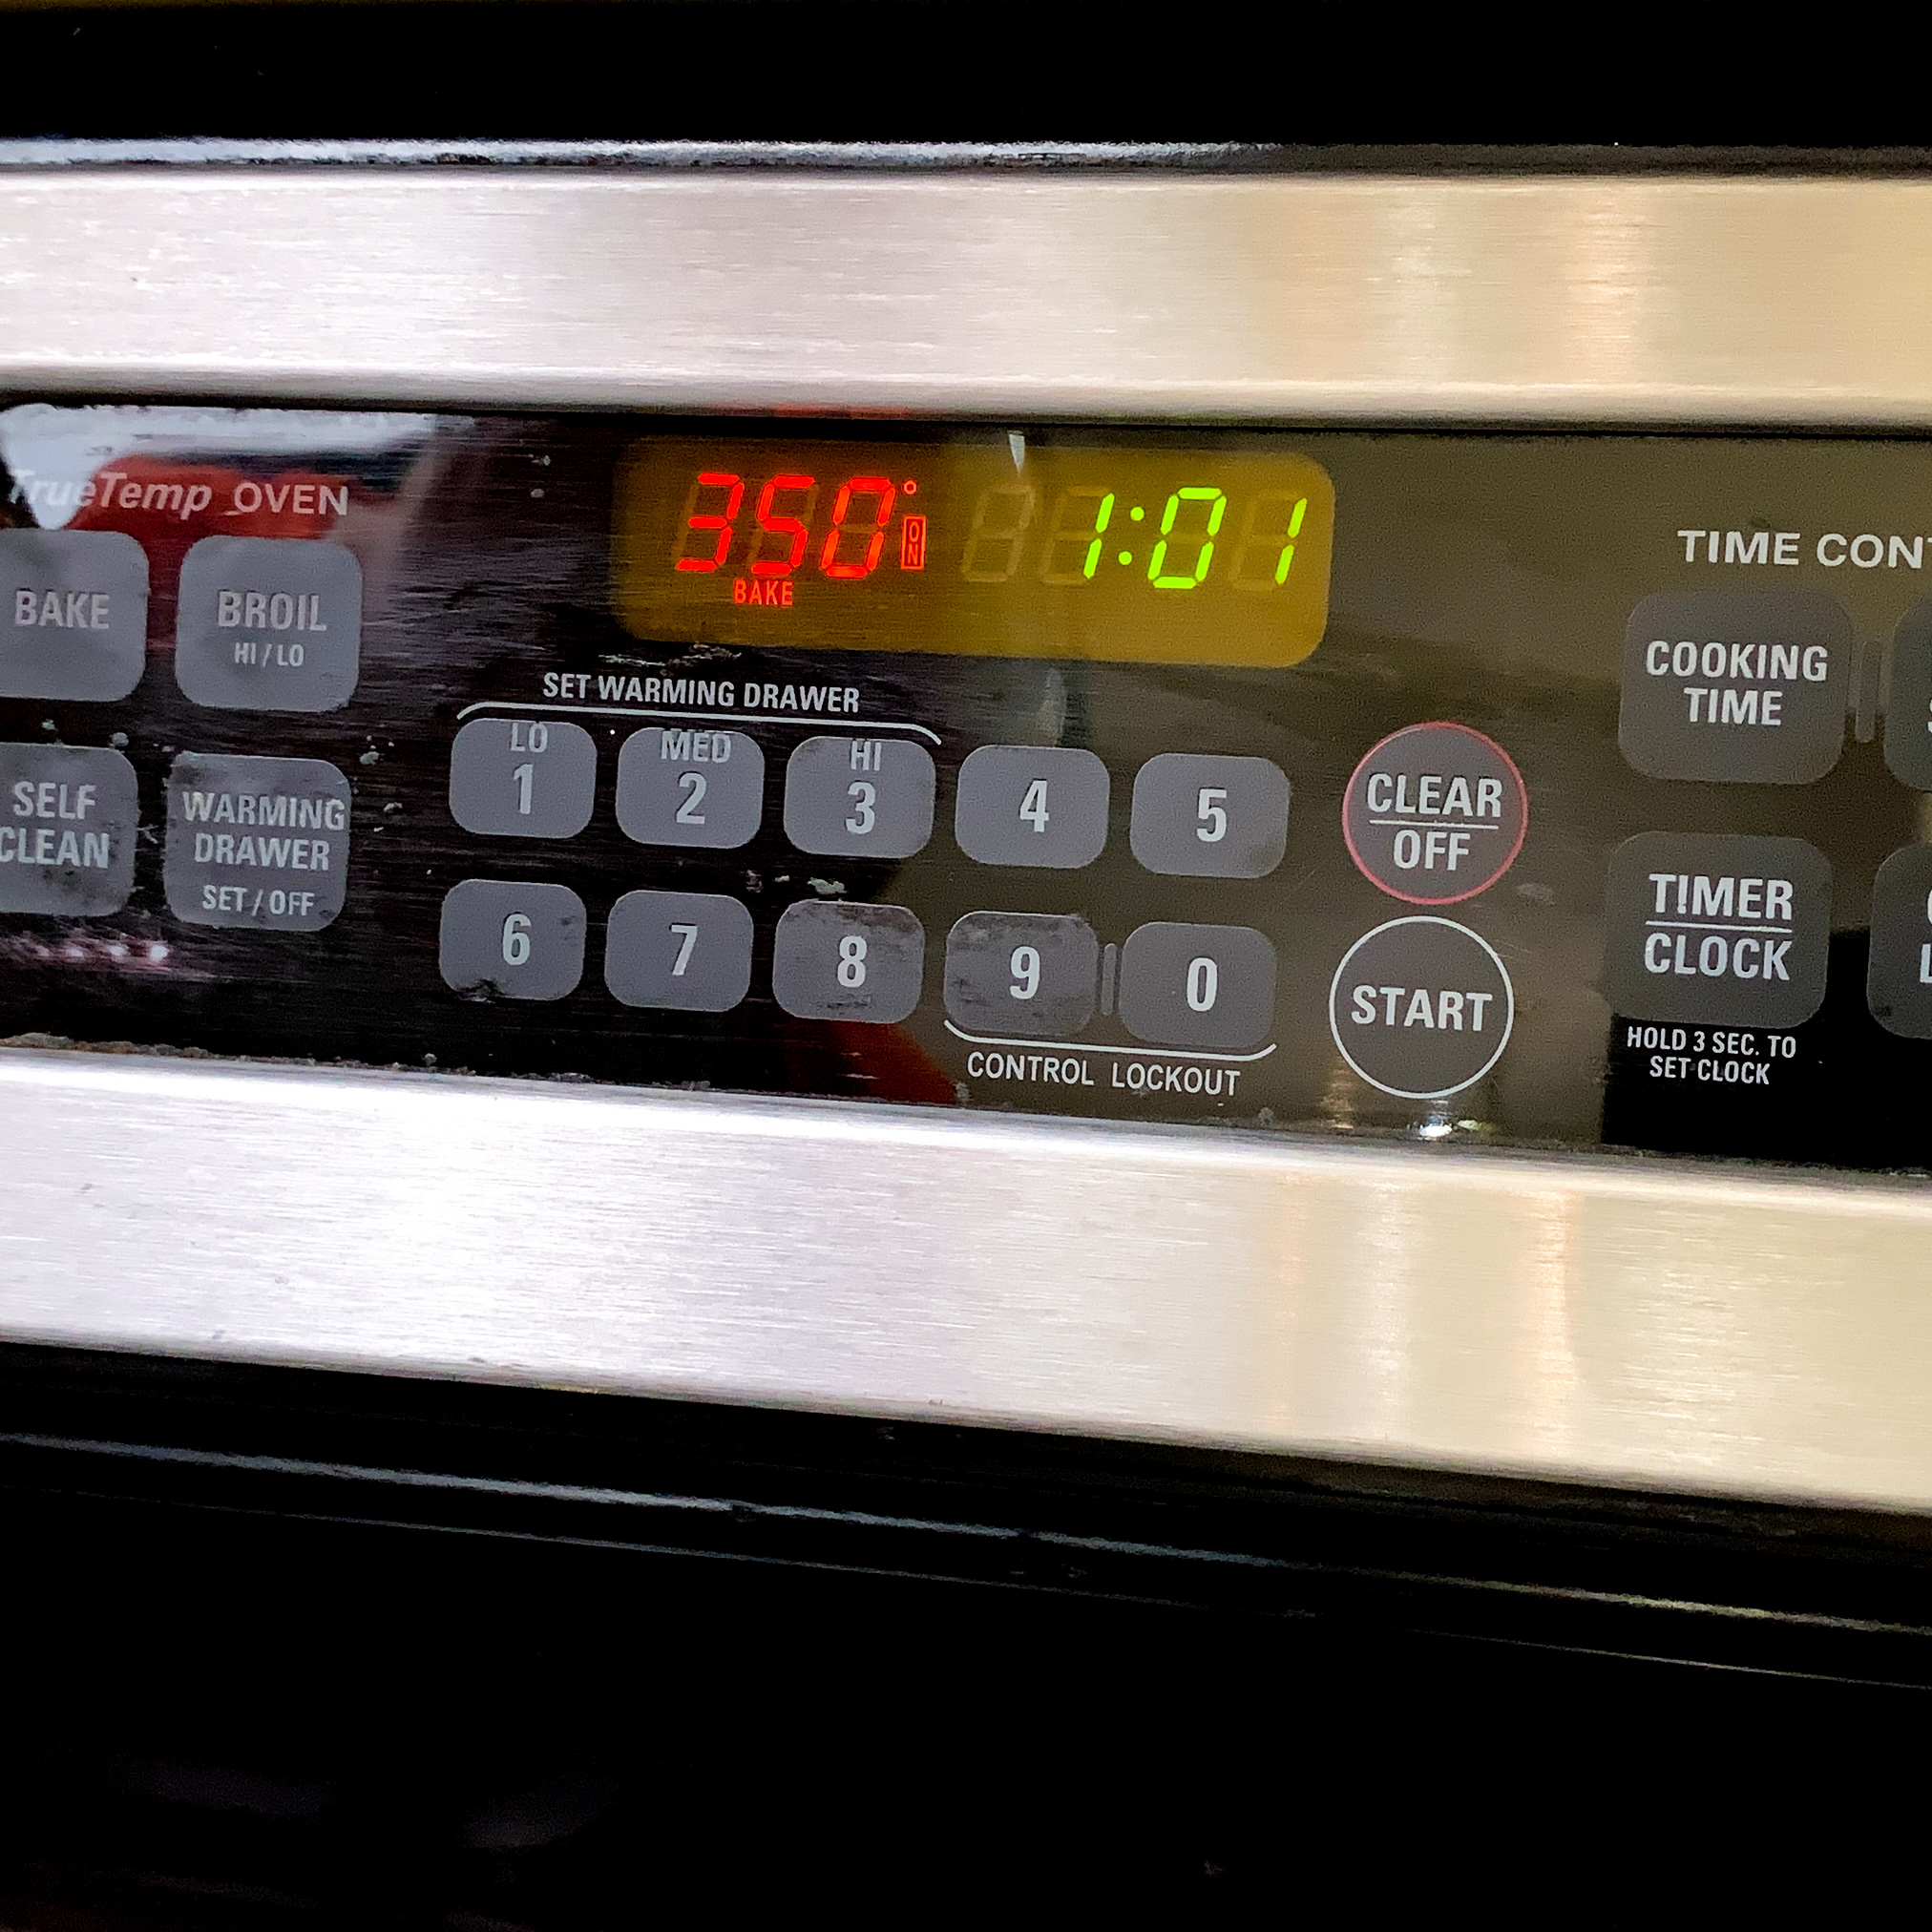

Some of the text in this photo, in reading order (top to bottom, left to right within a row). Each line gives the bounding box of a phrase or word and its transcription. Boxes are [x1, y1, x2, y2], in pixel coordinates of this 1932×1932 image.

[10, 469, 349, 520] TrueTemp OVEN
[1082, 486, 1308, 590] 1:01
[1676, 529, 1932, 570] TIME CON
[14, 590, 111, 630] BAKE
[218, 590, 327, 632] BROIL
[733, 578, 794, 607] BAKE
[1646, 640, 1828, 682] COOKING
[543, 672, 860, 714] SET WARMING DRAWER
[1683, 687, 1783, 726] TIME
[510, 723, 549, 754] LO
[661, 730, 732, 765] MED
[850, 740, 882, 772] HI
[13, 780, 97, 820] SELF
[181, 790, 346, 831] WARMING
[512, 764, 535, 816] 1
[675, 772, 709, 826] 2
[845, 781, 878, 834] 3
[1018, 779, 1050, 833] 4
[1366, 772, 1502, 819] CLEAR
[1195, 788, 1228, 843] 5
[0, 827, 111, 870] CLEAN
[194, 832, 330, 872] DRAWER
[1393, 829, 1471, 872] OFF
[1648, 872, 1794, 921] TIMER
[502, 914, 532, 967] 6
[670, 923, 700, 976] 7
[836, 934, 869, 988] 8
[1645, 932, 1792, 982] CLOCK
[1009, 945, 1041, 1001] 9
[1186, 956, 1219, 1013] 0
[1351, 983, 1493, 1033] START
[1627, 1026, 1796, 1060] HOLD 3 SEC. TO
[966, 1050, 1241, 1098] CONTROL LOCKOUT
[1648, 1055, 1772, 1085] SET CLOCK
